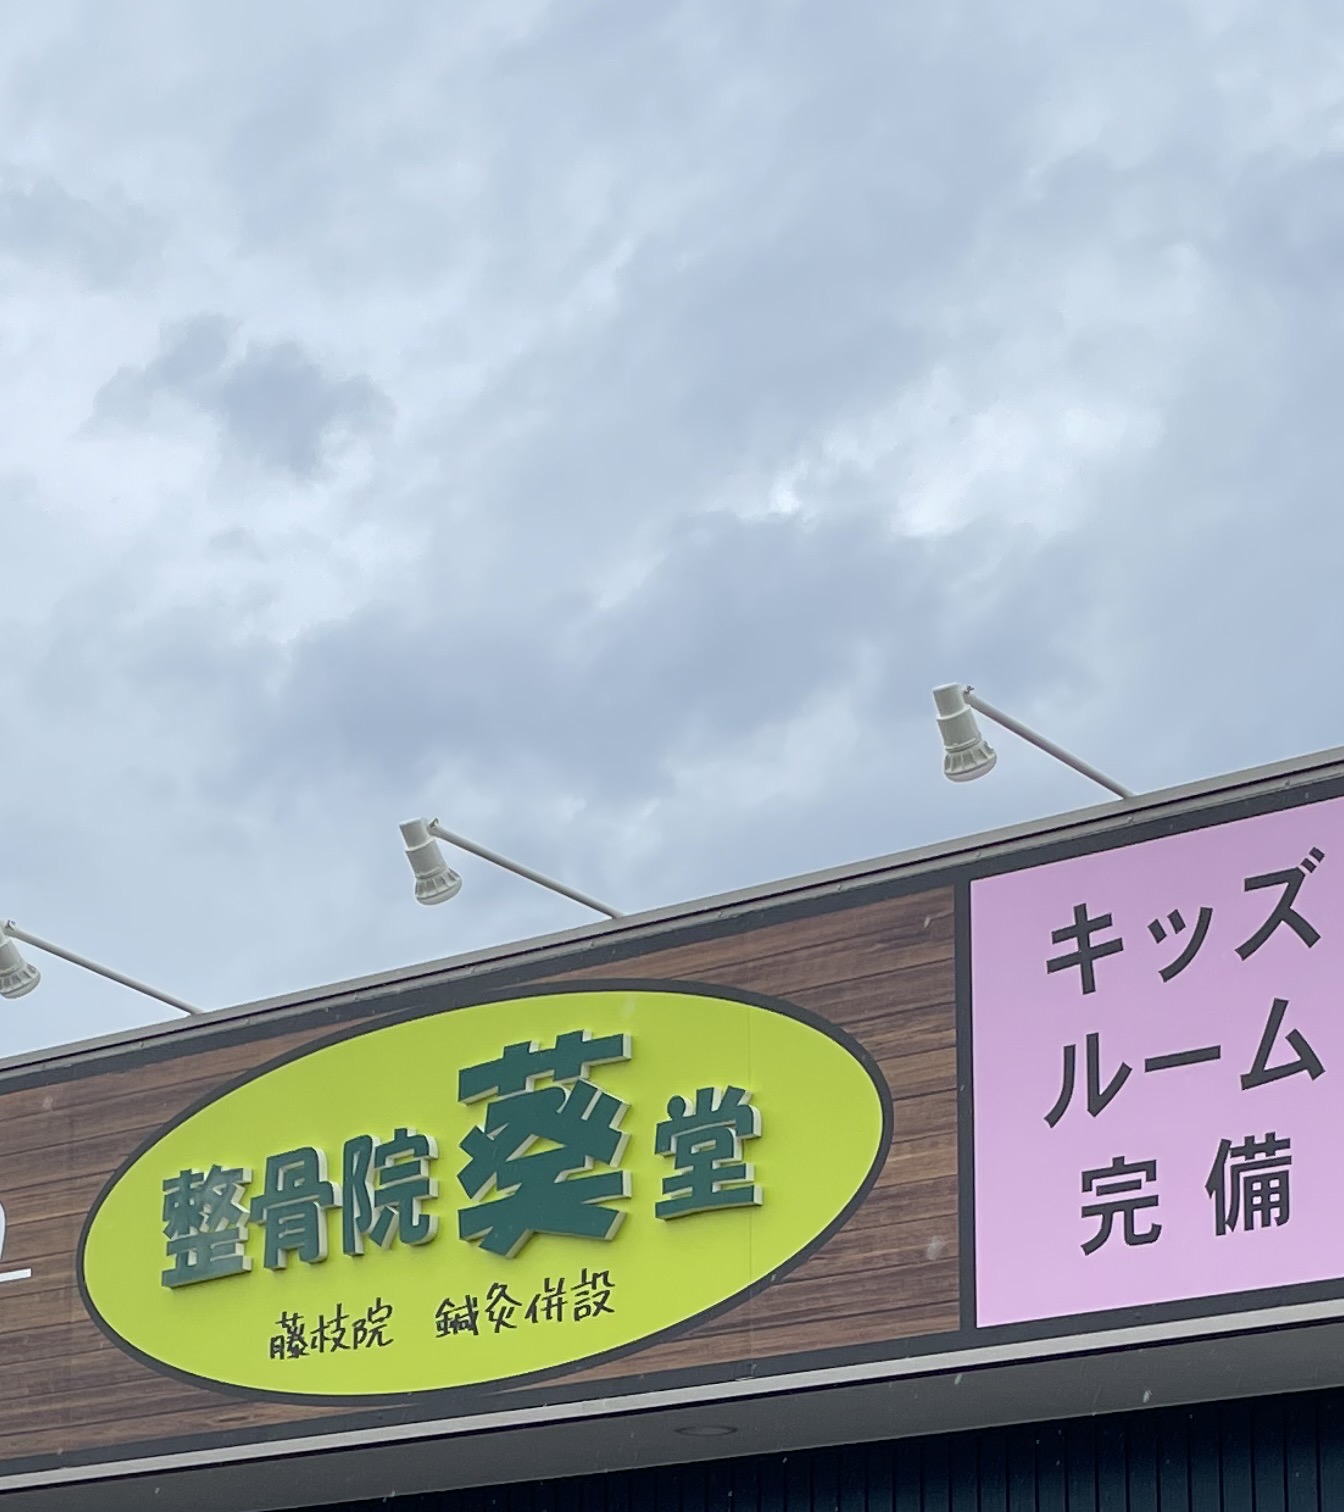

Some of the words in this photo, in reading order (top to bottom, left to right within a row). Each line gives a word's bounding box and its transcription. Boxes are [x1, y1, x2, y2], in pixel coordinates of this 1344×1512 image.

[1046, 847, 1325, 995] キッズ
[1044, 998, 1325, 1128] ルーム
[1080, 1132, 1293, 1256] 完備
[269, 1297, 395, 1361] 藤枝院
[434, 1268, 617, 1340] 鍼灸併設
